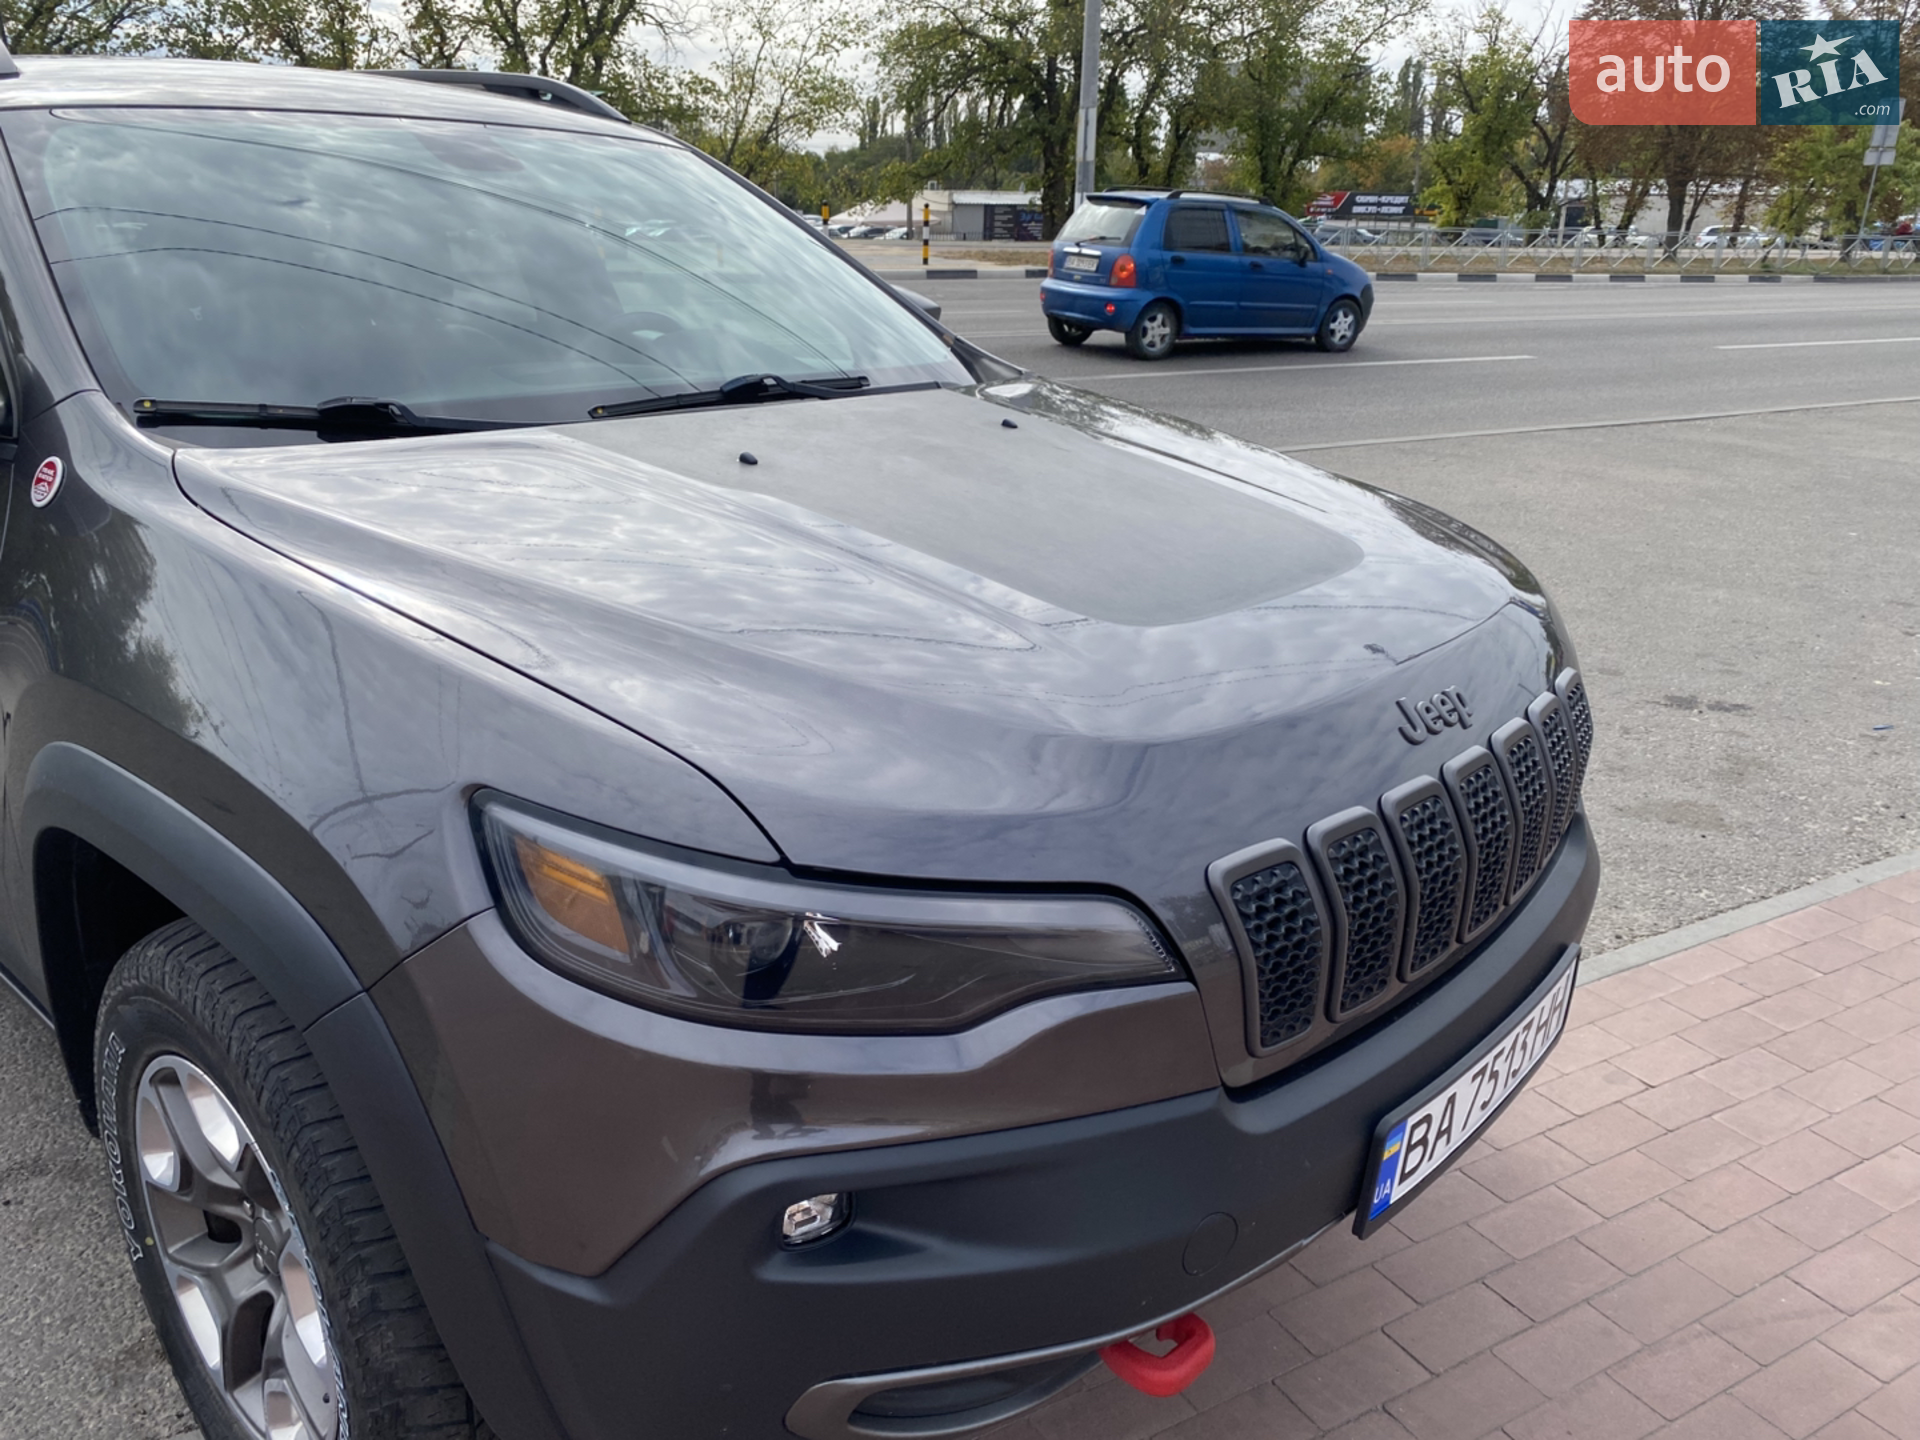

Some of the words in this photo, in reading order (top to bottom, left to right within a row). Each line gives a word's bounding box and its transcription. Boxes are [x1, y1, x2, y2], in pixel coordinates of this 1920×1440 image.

[1395, 685, 1474, 746] Jeep
[101, 1031, 144, 1262] YOKOHAMA
[1398, 1091, 1458, 1187] BA
[1373, 1177, 1392, 1204] UA
